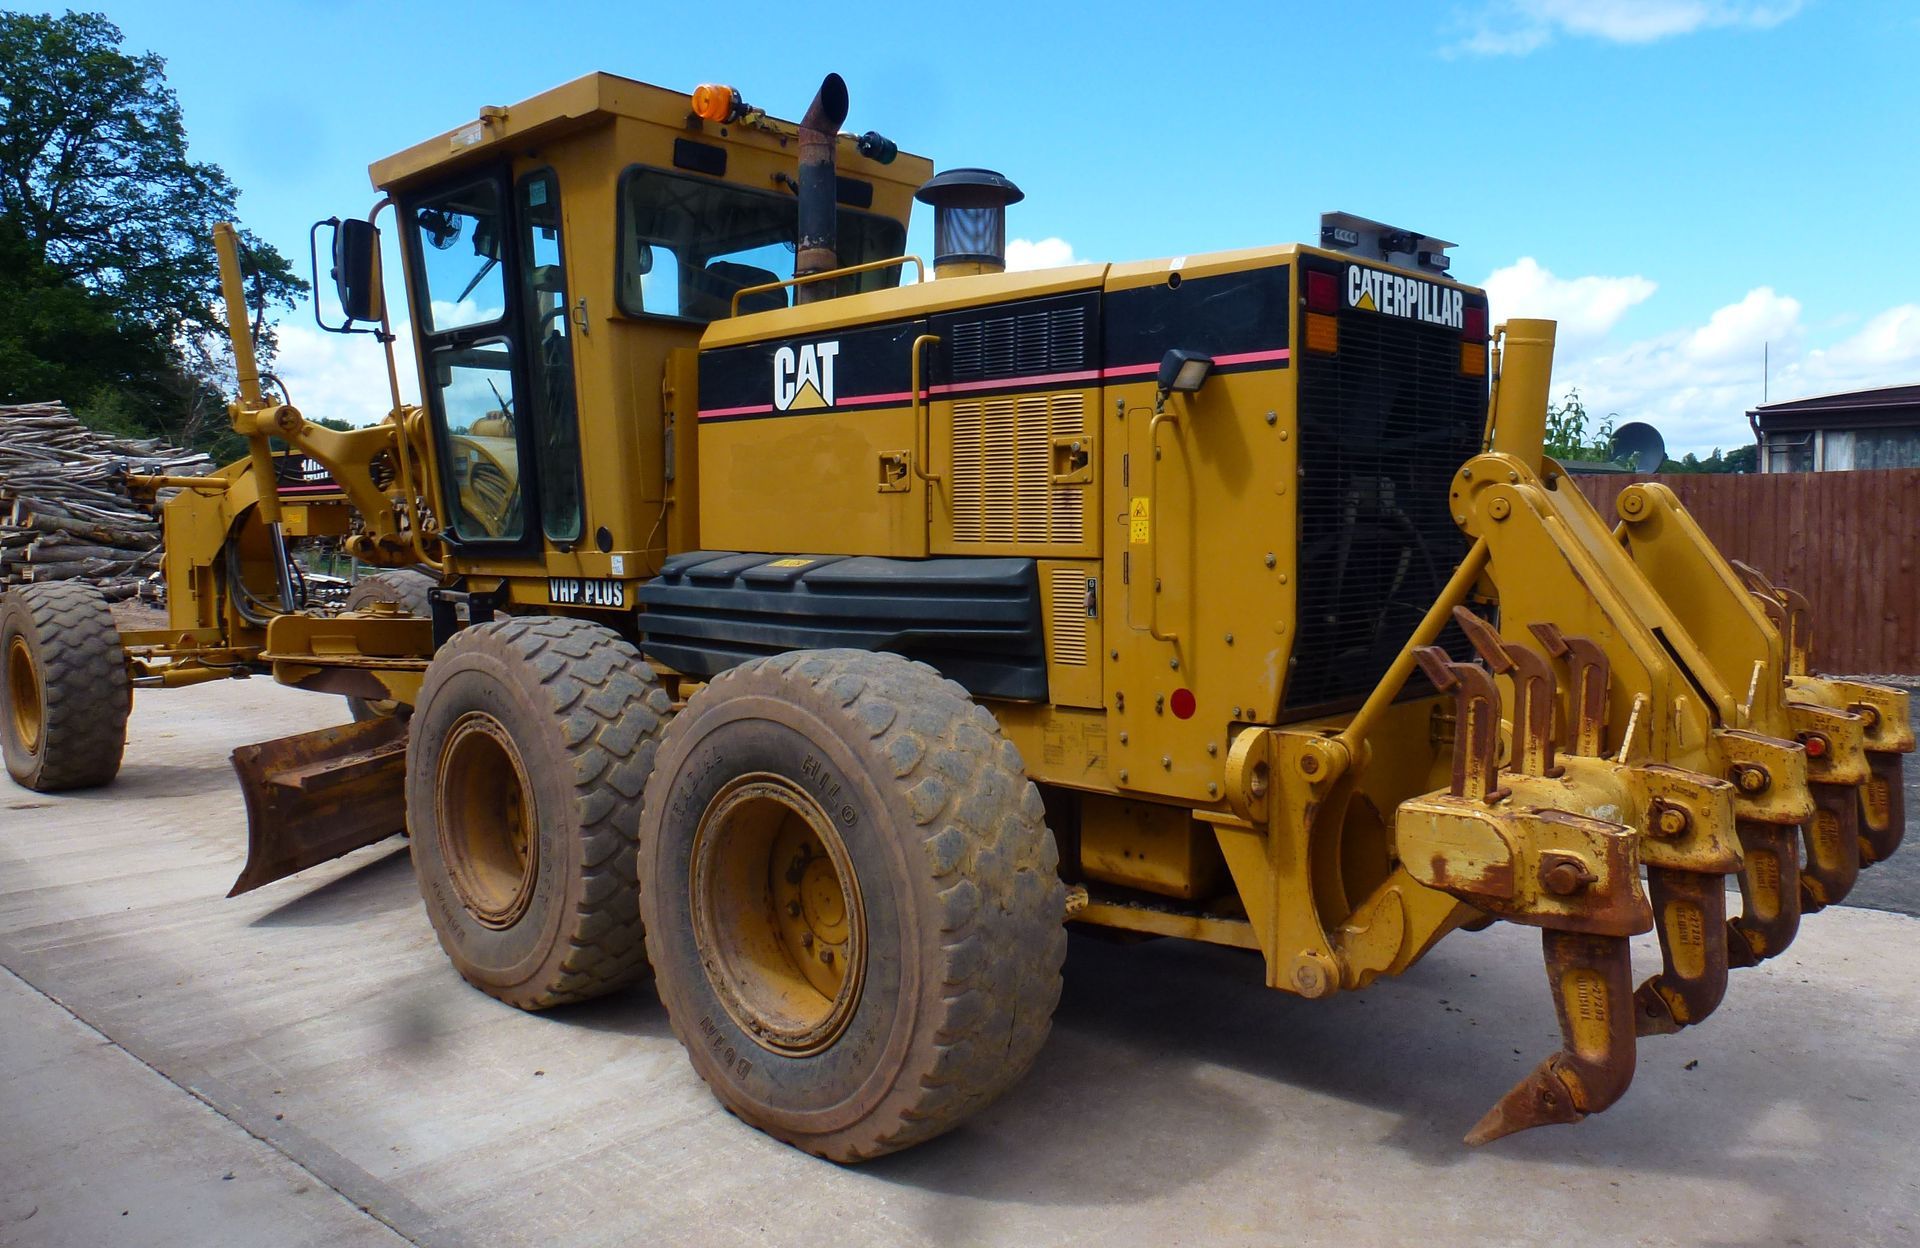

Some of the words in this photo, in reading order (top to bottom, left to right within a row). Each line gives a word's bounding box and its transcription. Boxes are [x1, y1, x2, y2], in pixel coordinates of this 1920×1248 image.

[1348, 264, 1463, 329] CATERPILLAR
[774, 340, 839, 411] CAT
[550, 579, 579, 602] VHP
[585, 580, 623, 606] PLUS
